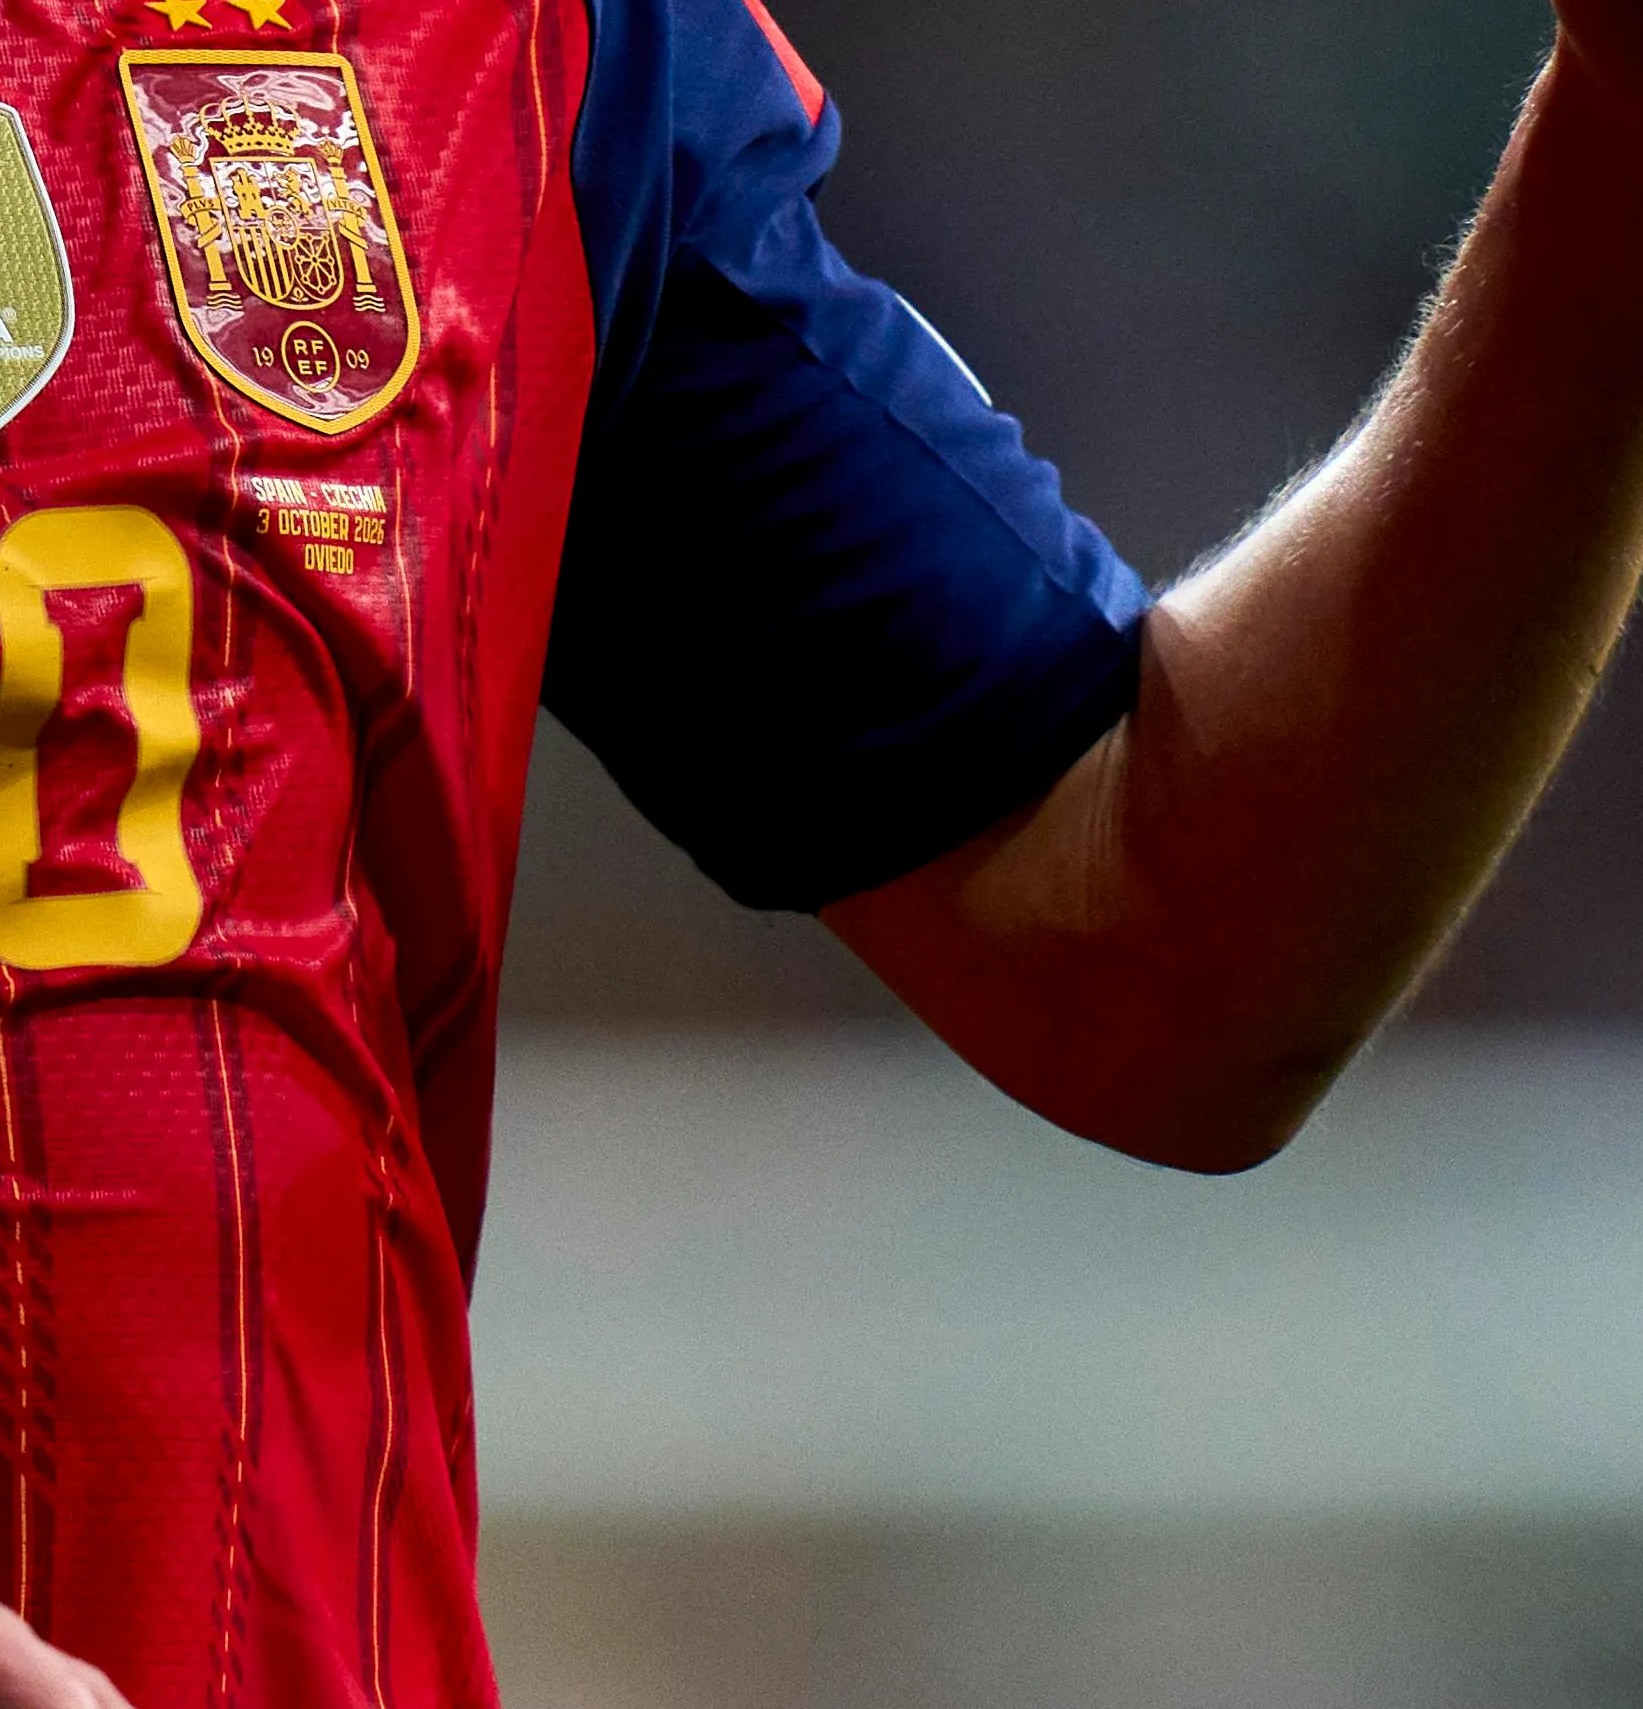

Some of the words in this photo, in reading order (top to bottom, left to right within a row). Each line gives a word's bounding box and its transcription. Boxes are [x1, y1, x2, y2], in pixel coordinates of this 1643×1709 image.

[252, 346, 274, 367] 19
[346, 349, 370, 369] 09
[251, 476, 308, 505] SPAIN
[320, 482, 387, 513] CZECHIA
[256, 508, 270, 534] 3
[278, 508, 349, 541] OCTOBER
[353, 515, 386, 545] 2026
[304, 543, 354, 575] OVIEDO
